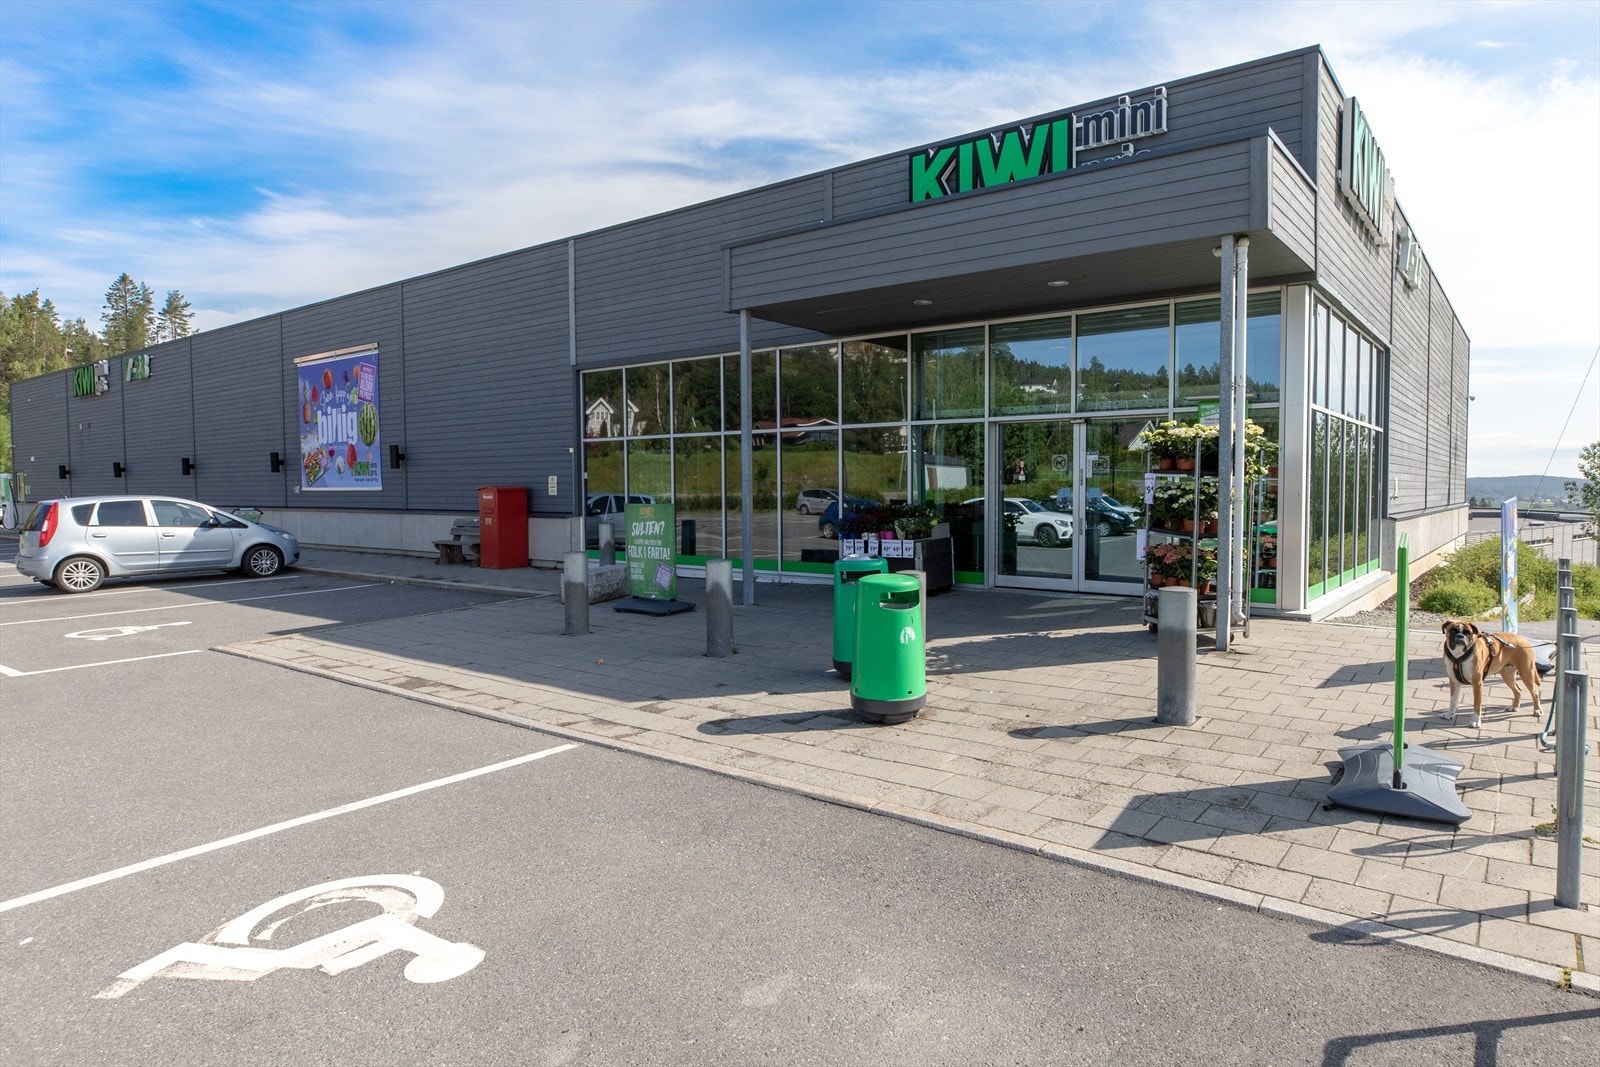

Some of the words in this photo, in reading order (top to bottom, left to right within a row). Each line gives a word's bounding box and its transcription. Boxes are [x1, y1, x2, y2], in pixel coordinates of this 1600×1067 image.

[910, 114, 1072, 203] KIWI
[1082, 86, 1169, 146] mini
[73, 365, 95, 397] KIWI
[317, 404, 358, 446] billig
[631, 520, 665, 536] SULTEN?
[628, 545, 642, 558] FOLK
[643, 546, 647, 558] I
[647, 547, 670, 560] FARTA!
